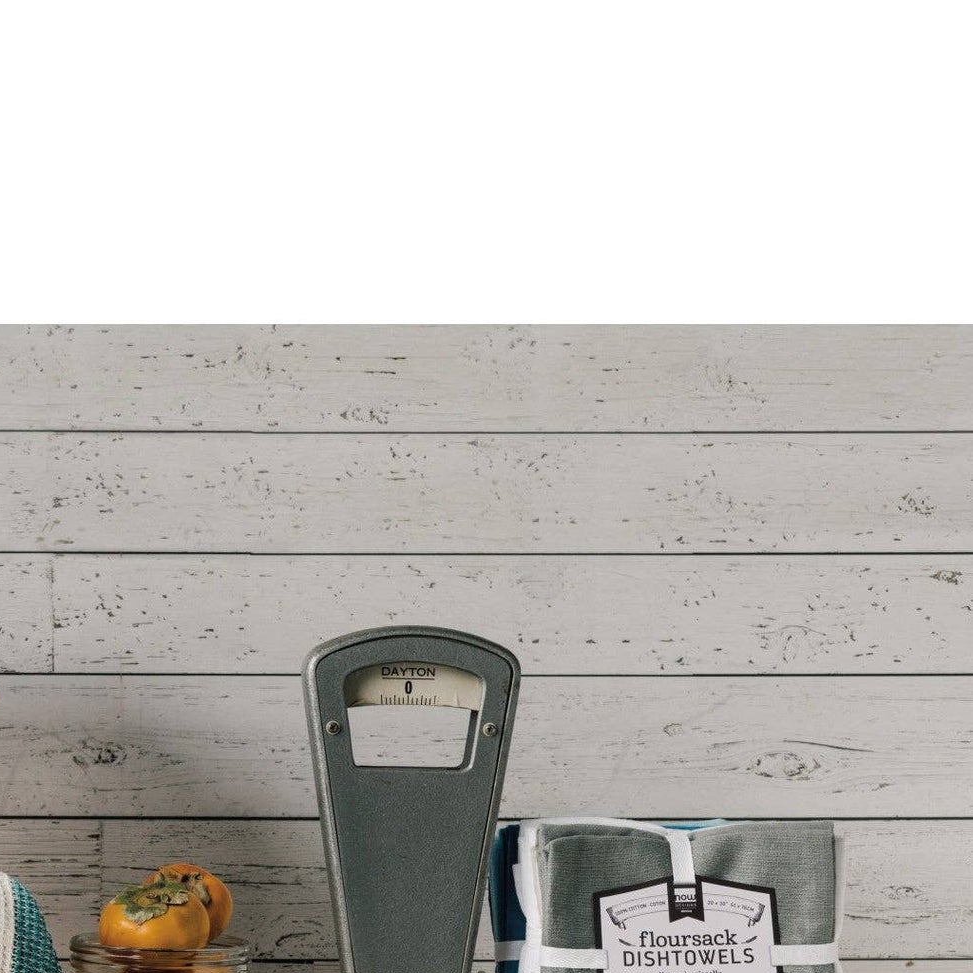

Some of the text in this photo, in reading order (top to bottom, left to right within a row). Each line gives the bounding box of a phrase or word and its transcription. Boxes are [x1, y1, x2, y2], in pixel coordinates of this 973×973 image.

[381, 666, 436, 677] DAYTON
[404, 680, 412, 694] 0
[674, 893, 697, 901] now
[639, 929, 738, 948] floursack
[623, 948, 755, 967] DISHTOWELS
